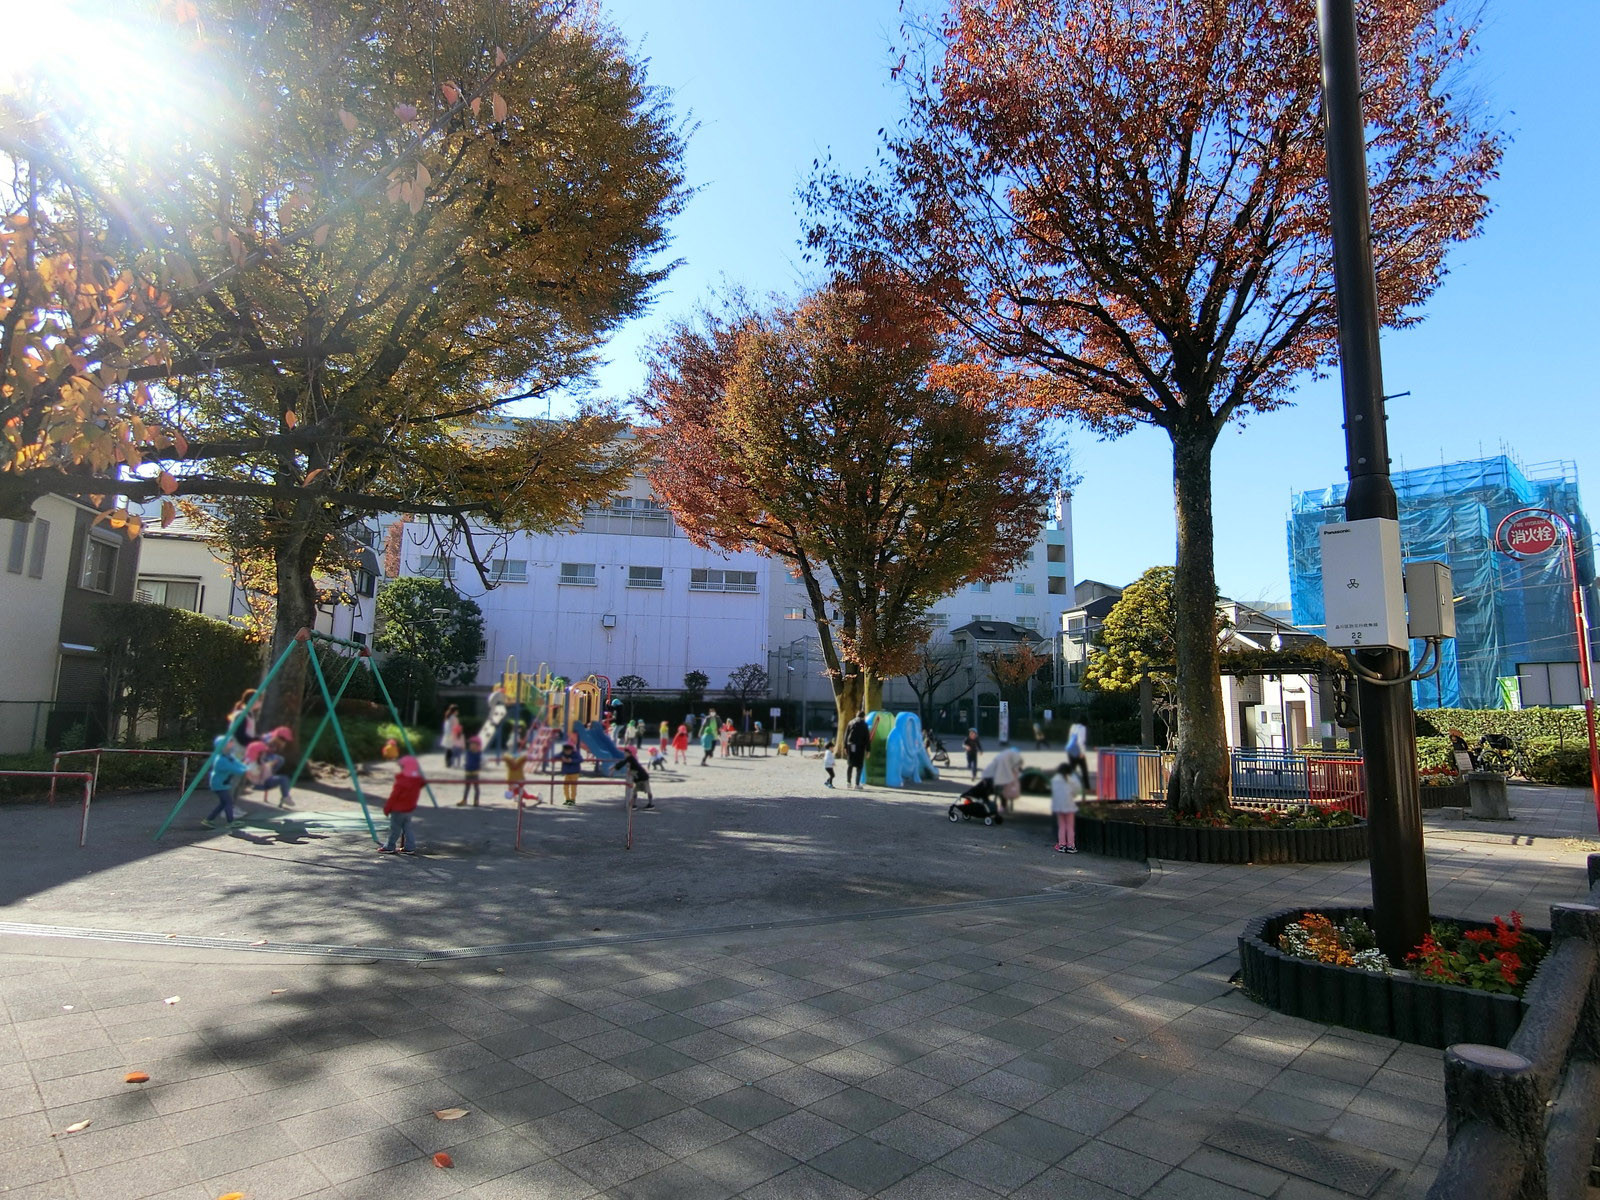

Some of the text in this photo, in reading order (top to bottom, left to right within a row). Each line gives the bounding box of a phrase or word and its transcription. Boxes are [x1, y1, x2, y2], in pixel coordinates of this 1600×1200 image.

[1510, 525, 1553, 544] 消火栓
[1351, 631, 1362, 639] 22
